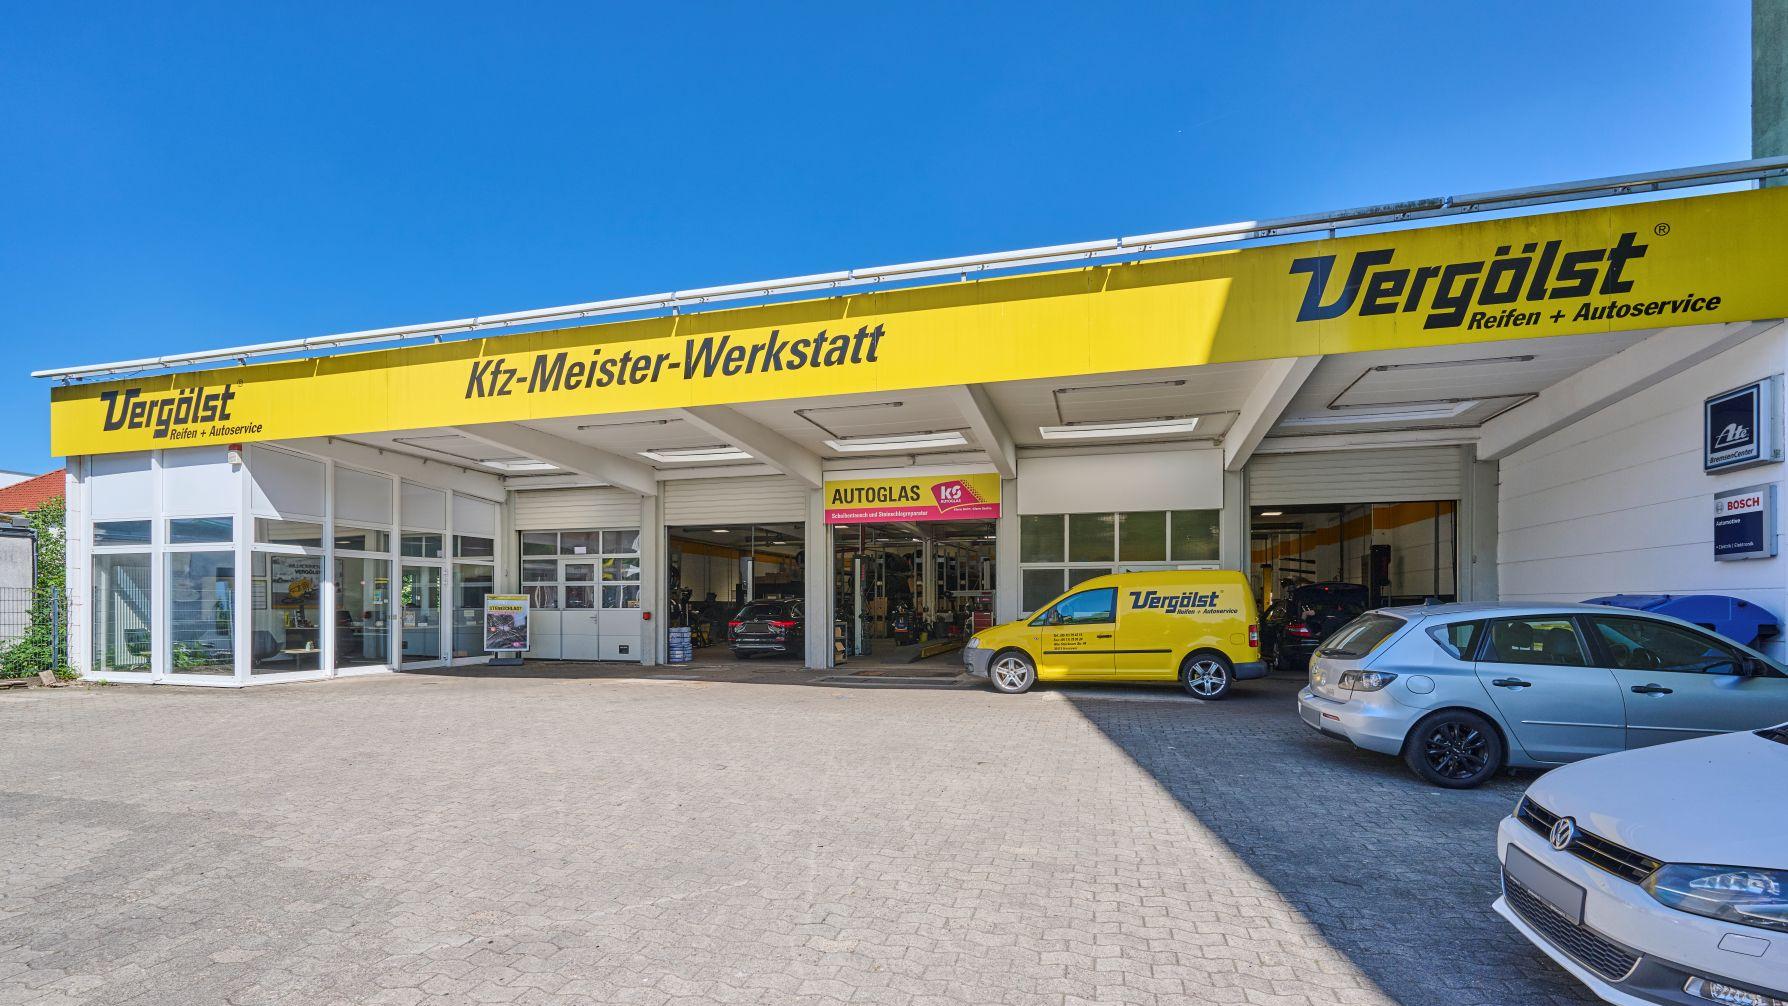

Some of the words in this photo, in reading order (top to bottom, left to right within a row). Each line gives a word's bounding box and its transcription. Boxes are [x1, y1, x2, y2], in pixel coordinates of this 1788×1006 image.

[1289, 232, 1648, 330] Vergölst
[1467, 310, 1540, 331] Reifen
[1572, 294, 1721, 322] Autoservice
[465, 323, 886, 399] Kfz-Meister-Werkstatt
[100, 384, 236, 439] Vergölst
[170, 429, 198, 440] Reifen
[209, 422, 263, 437] Autoservice
[1709, 448, 1754, 464] BremsenCenter
[831, 485, 921, 505] AUTOGLAS
[1727, 497, 1760, 511] BOSCH
[1129, 590, 1220, 614] Vergölst
